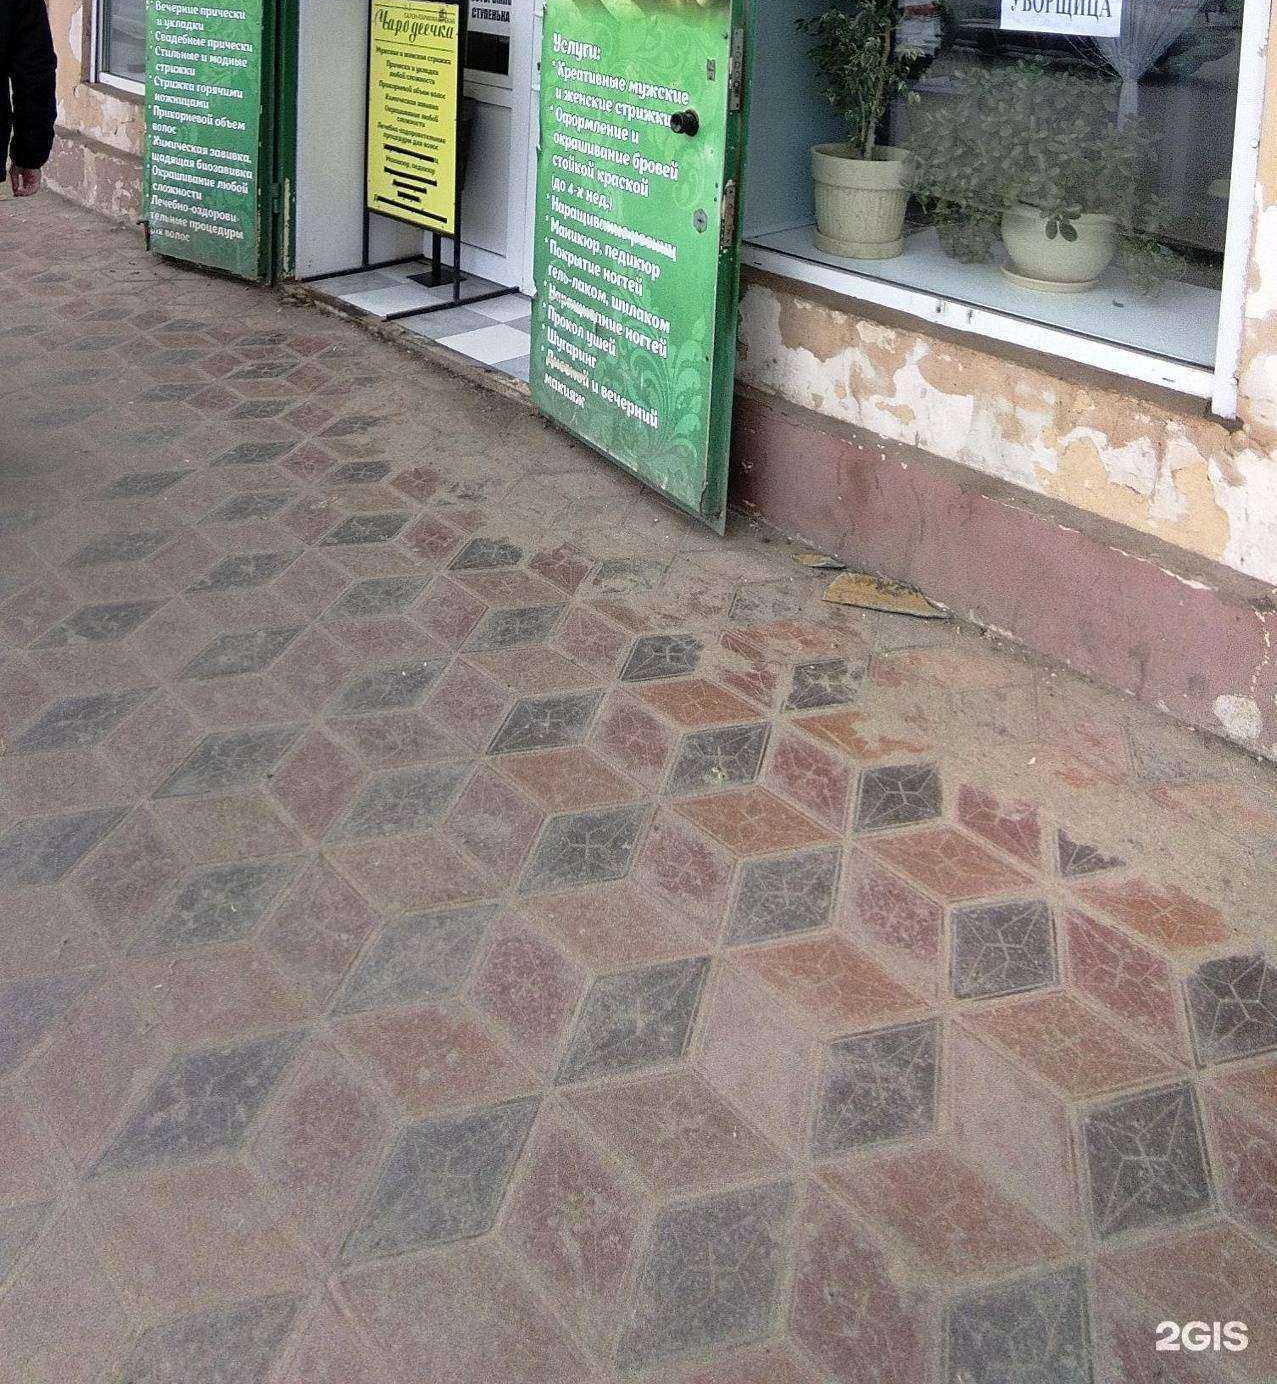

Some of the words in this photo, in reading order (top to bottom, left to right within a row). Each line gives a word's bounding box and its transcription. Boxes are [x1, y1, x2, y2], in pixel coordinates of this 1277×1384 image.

[472, 7, 511, 23] СТУПЕНЬКА
[155, 31, 206, 47] Свадебные
[207, 39, 253, 53] прически
[155, 46, 200, 62] Стильные
[209, 54, 248, 68] модные
[553, 32, 601, 61] Услуги:
[555, 87, 563, 100] и
[564, 90, 613, 113] женские
[629, 80, 690, 106] мужские
[152, 123, 177, 135] волос
[555, 107, 629, 142] Оформление
[631, 131, 639, 144] и
[554, 132, 630, 165] окрашивание
[633, 151, 679, 180] бровей
[552, 155, 595, 179] стойкой
[597, 169, 649, 197] краской
[549, 238, 601, 276] Покрытие
[603, 267, 643, 297] ногтей
[604, 244, 661, 281] педикюр
[548, 304, 584, 339] Прокол
[547, 326, 597, 369] Шугаринг
[625, 326, 667, 359] ногтей
[591, 380, 599, 394] и
[600, 384, 658, 429] вечерний
